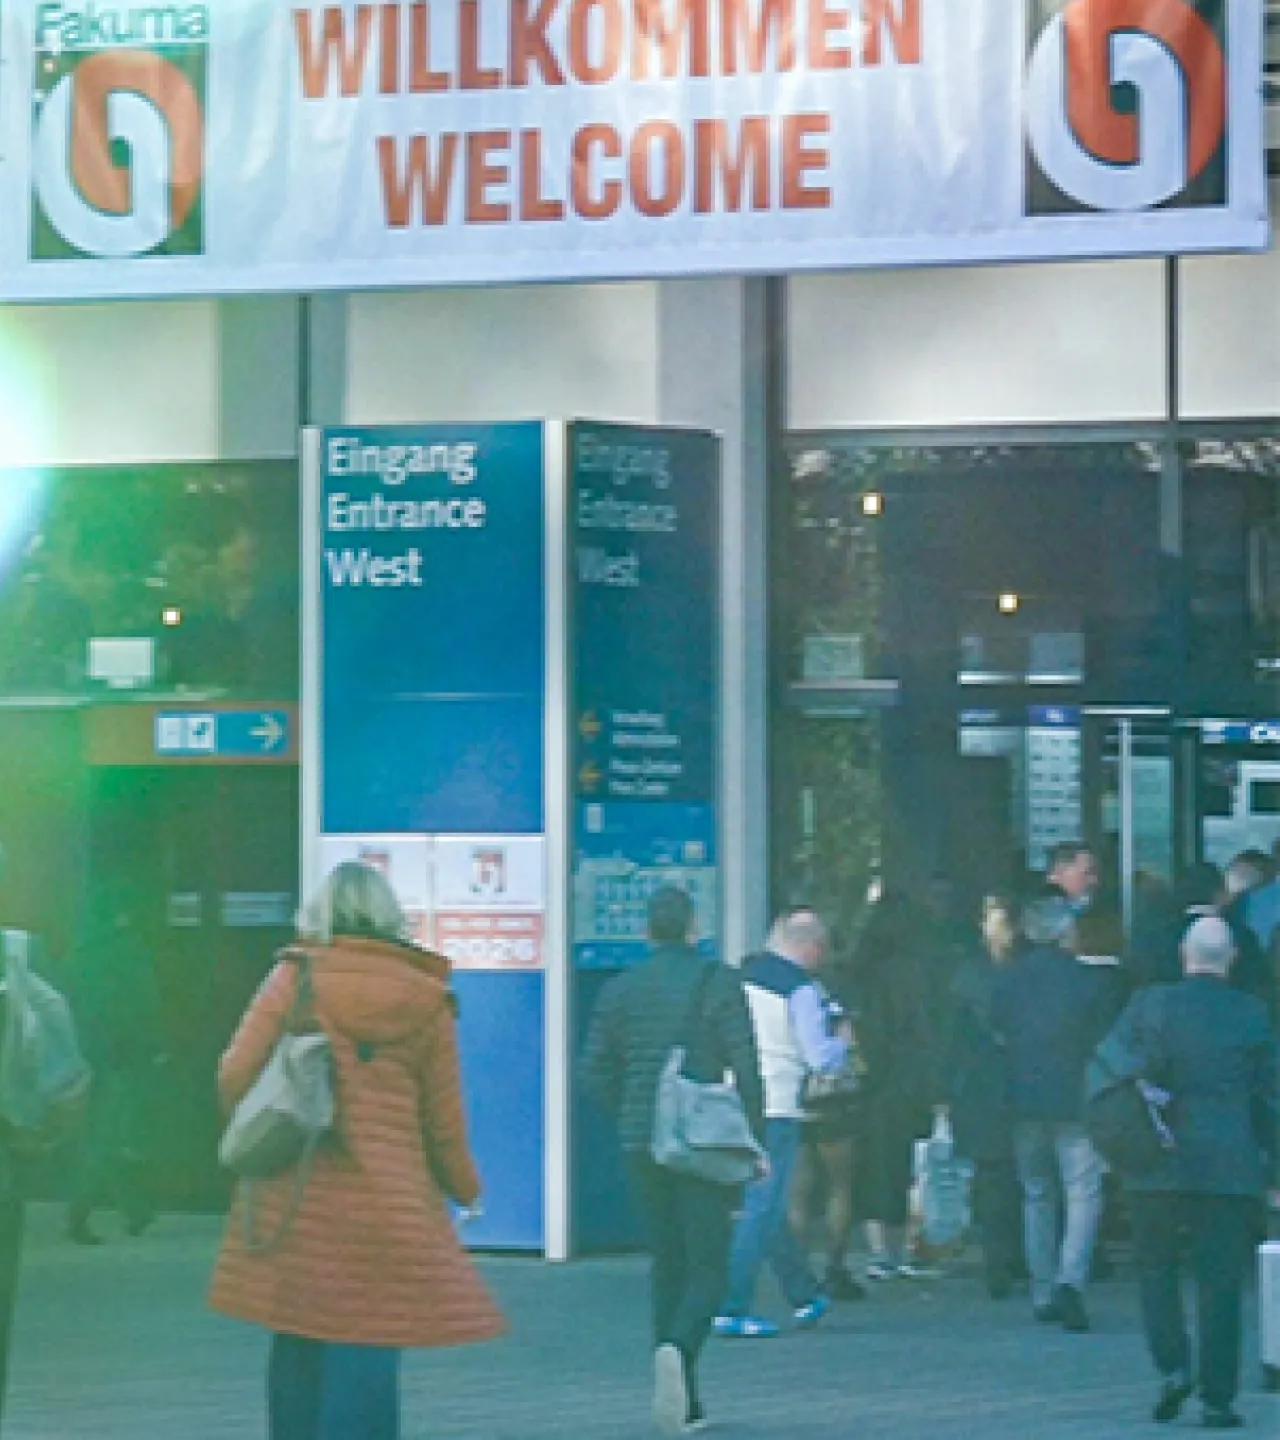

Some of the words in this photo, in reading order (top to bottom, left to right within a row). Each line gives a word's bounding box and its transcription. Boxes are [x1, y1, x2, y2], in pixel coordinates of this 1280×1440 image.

[35, 2, 212, 48] Fakuma
[376, 113, 833, 230] WELCOME
[327, 437, 478, 484] Eingang
[577, 433, 672, 489] Eingang
[327, 492, 487, 528] Entrance
[577, 489, 677, 532] Entrance
[325, 548, 424, 587] West
[577, 548, 639, 588] West
